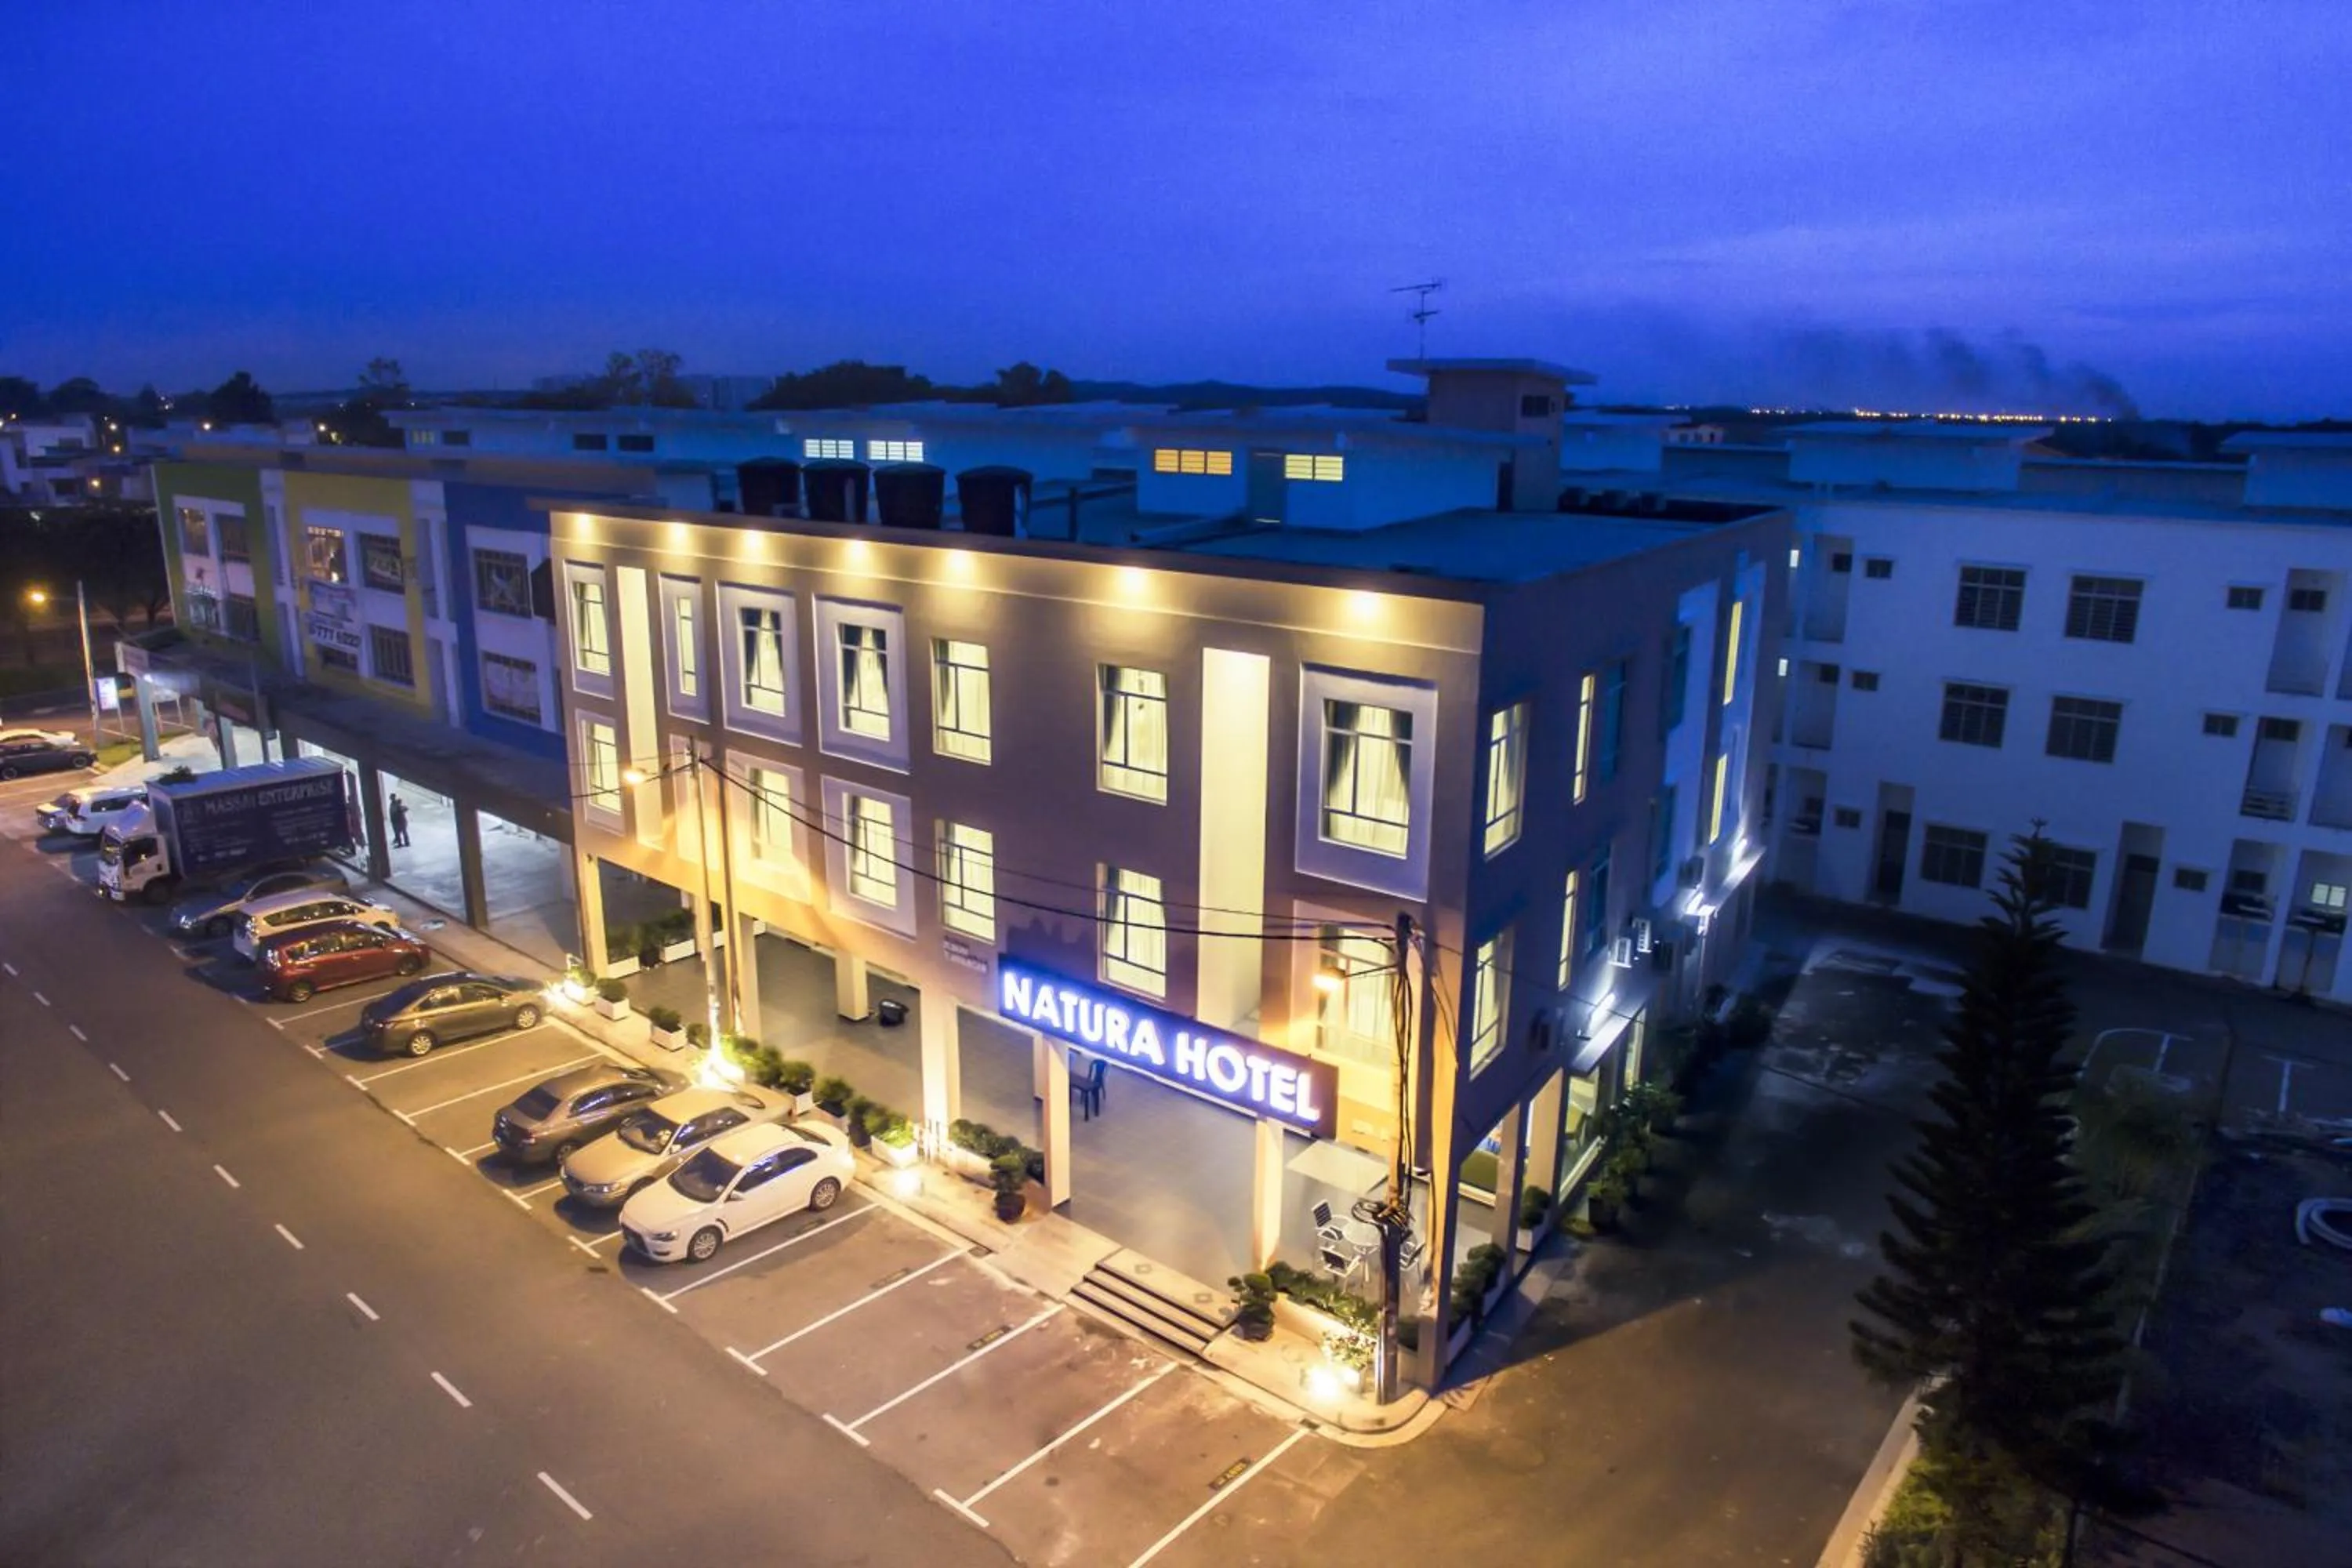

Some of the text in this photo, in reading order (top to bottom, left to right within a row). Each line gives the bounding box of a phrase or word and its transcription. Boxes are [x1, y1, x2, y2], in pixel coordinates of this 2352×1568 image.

[258, 779, 334, 806] ENTERPRISE
[1003, 971, 1320, 1122] NATURA HOTEL
